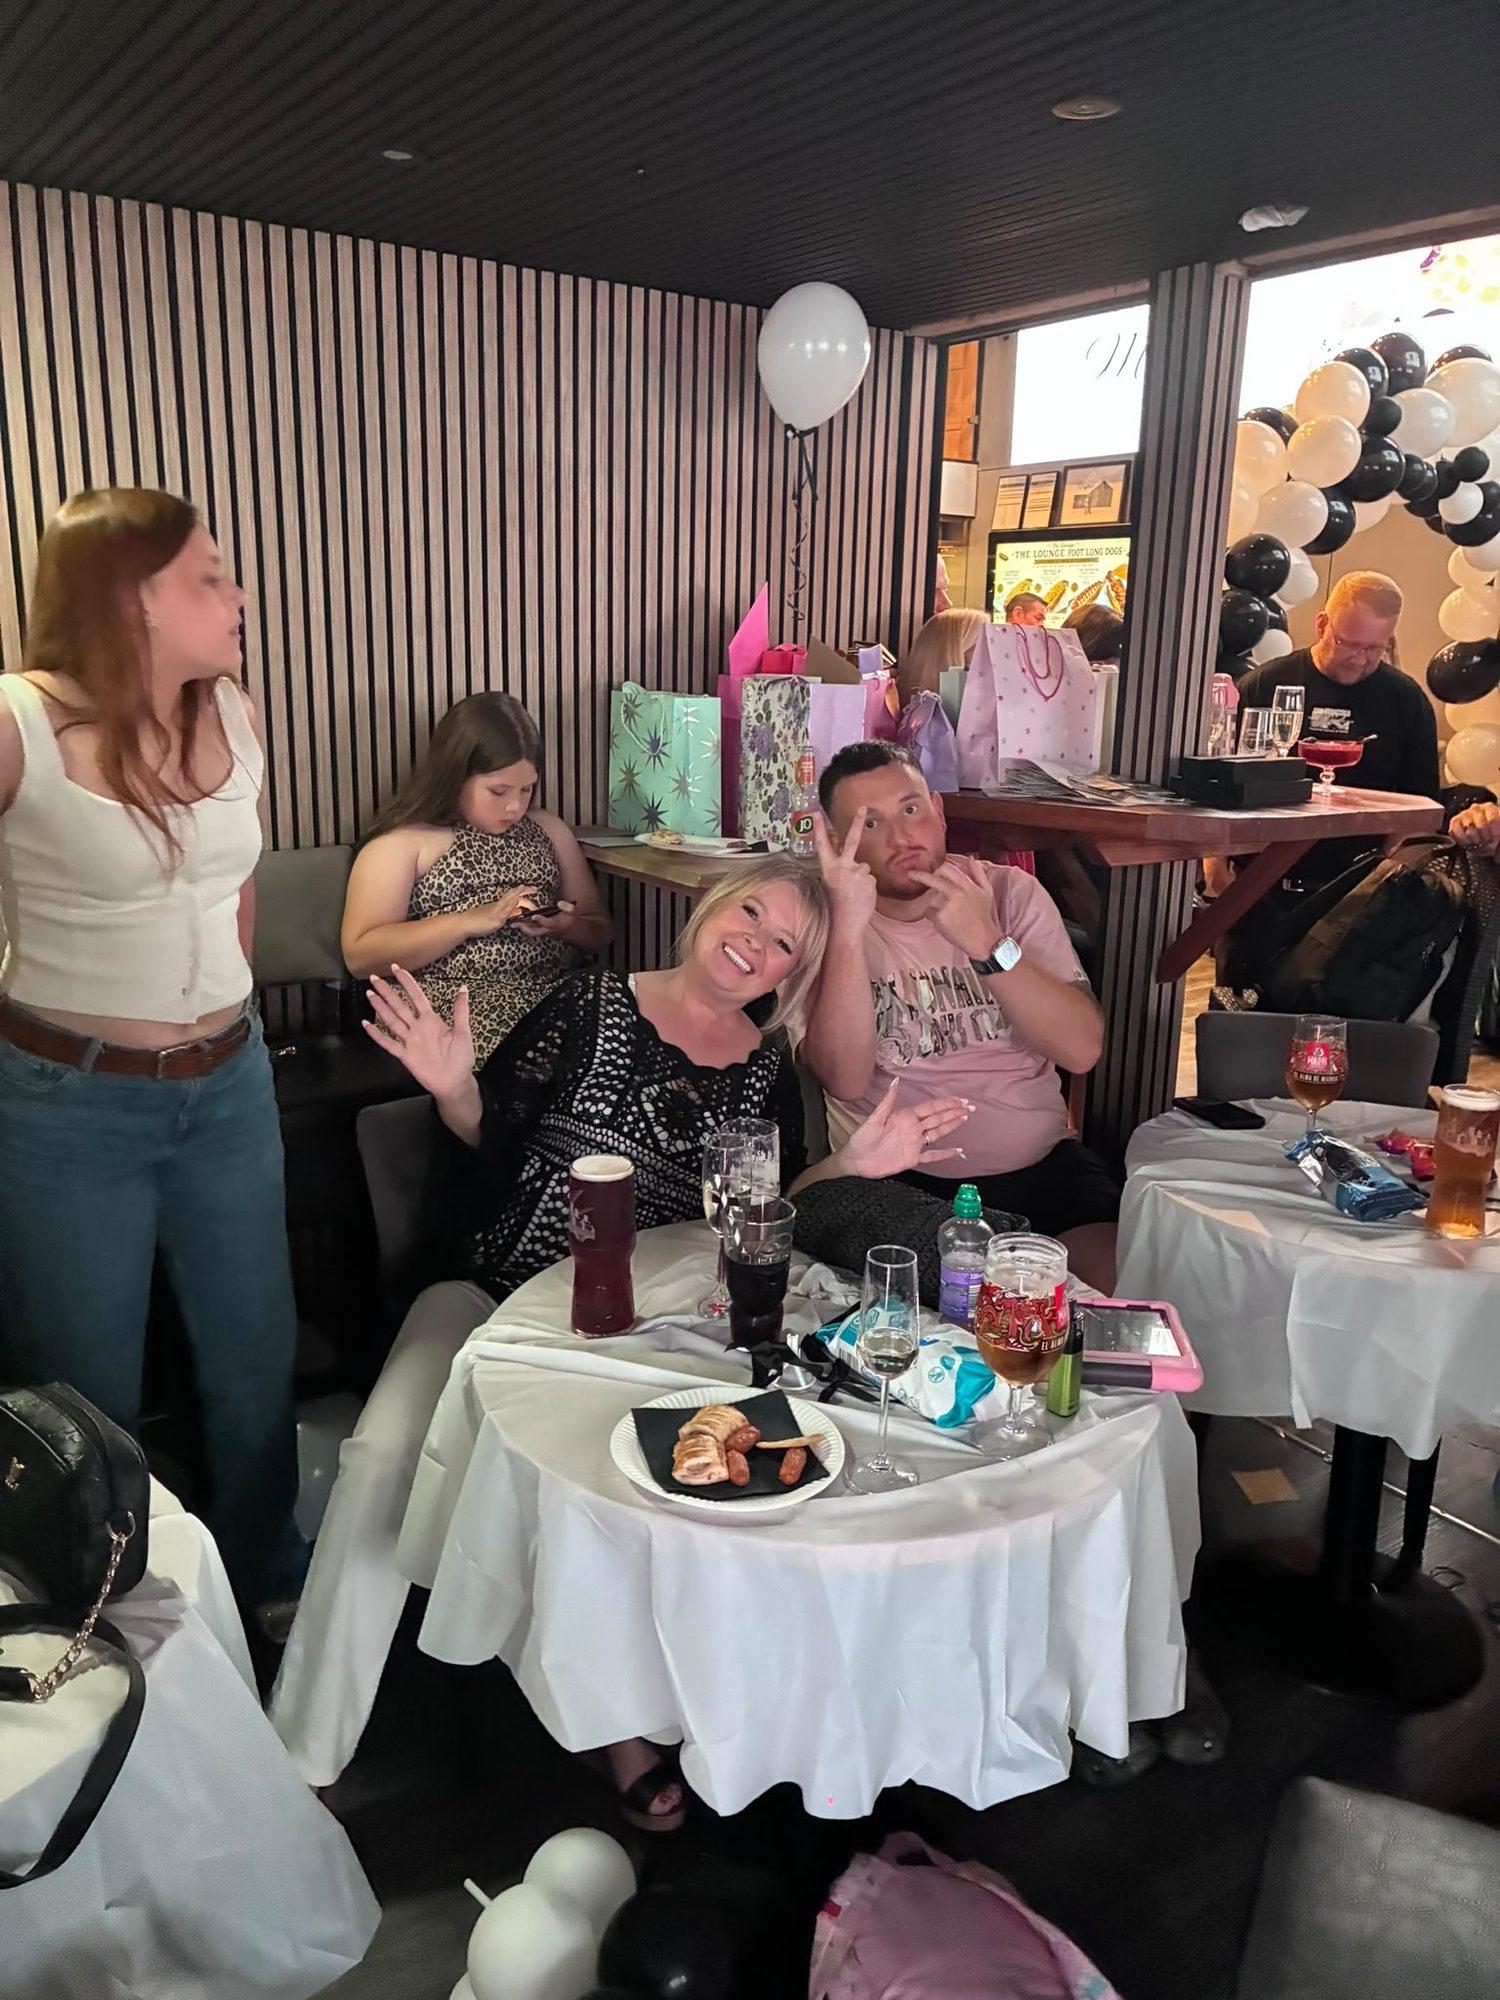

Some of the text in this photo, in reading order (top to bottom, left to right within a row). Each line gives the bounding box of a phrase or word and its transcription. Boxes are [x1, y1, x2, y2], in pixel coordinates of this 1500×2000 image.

[1015, 547, 1123, 559] THE LOUNGE FOOT LONG DOGS
